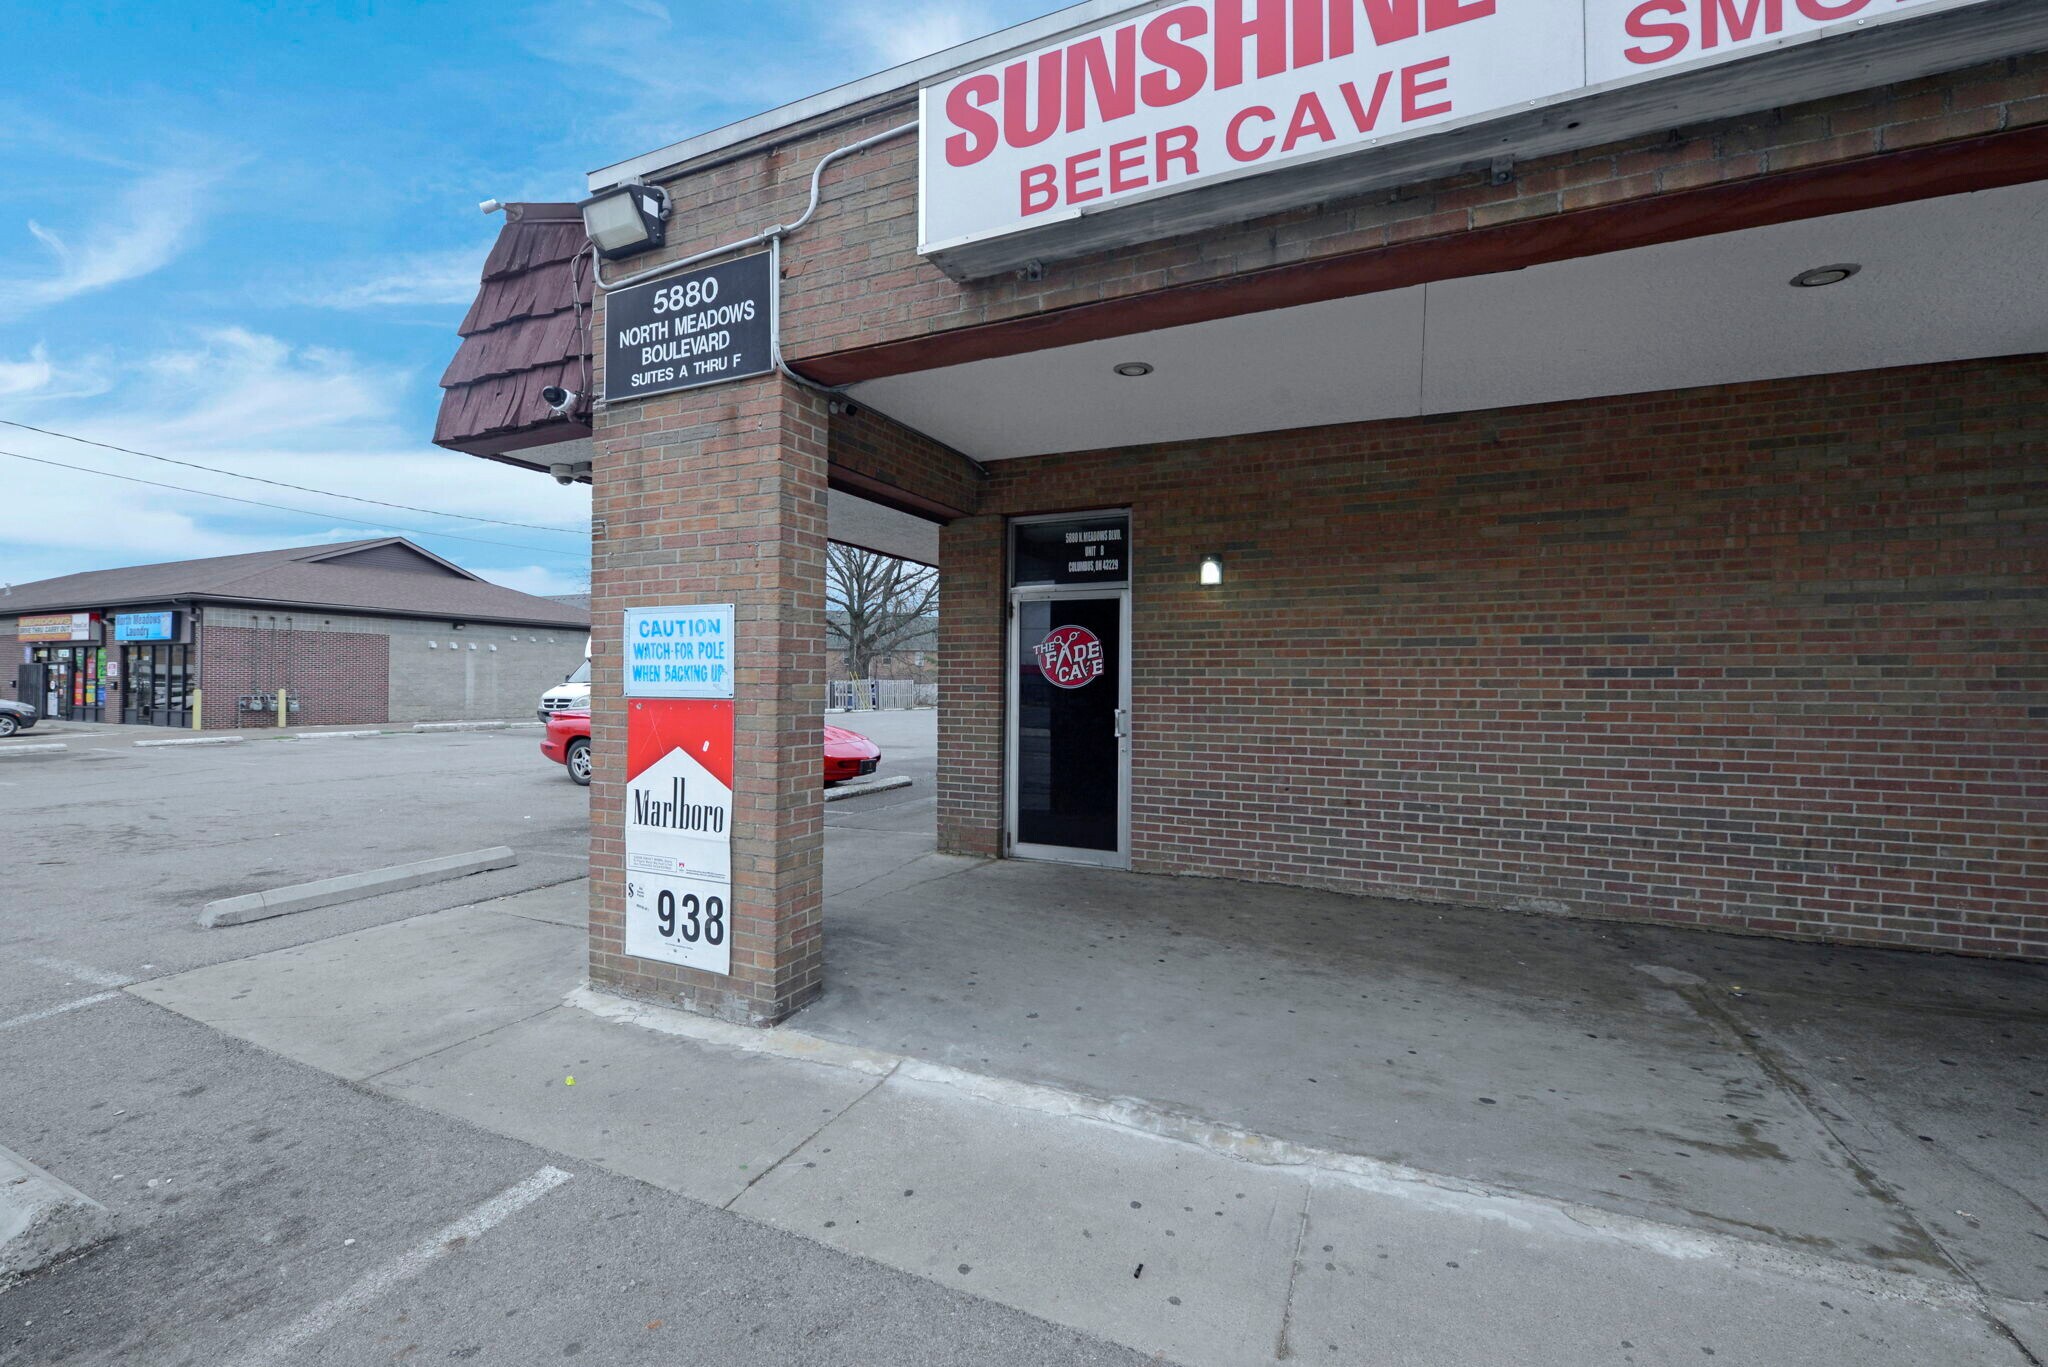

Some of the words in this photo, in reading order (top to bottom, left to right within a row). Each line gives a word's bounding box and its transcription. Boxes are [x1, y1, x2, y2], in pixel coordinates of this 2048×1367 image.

[945, 0, 1496, 168] SUNSHIN
[1020, 125, 1200, 218] BEER
[1225, 55, 1453, 163] CAVE
[652, 276, 719, 314] 5880
[619, 320, 669, 349] NORTH
[674, 299, 755, 337] MEADOWS
[641, 330, 730, 366] BOULEVARD
[631, 367, 674, 387] SUITES
[678, 364, 689, 378] A
[693, 356, 728, 375] THRU
[732, 353, 742, 367] F
[1085, 546, 1096, 557] UNIT
[126, 627, 149, 639] Laundry
[133, 614, 161, 625] Meadows
[639, 618, 721, 638] CAUTION
[633, 642, 670, 660] WATCH
[674, 642, 693, 660] FOR
[698, 641, 725, 660] POLE
[1033, 642, 1055, 655] THE
[632, 665, 661, 682] WHEN
[664, 664, 707, 682] BACKING
[711, 664, 725, 682] UP
[632, 776, 724, 834] Marlboro
